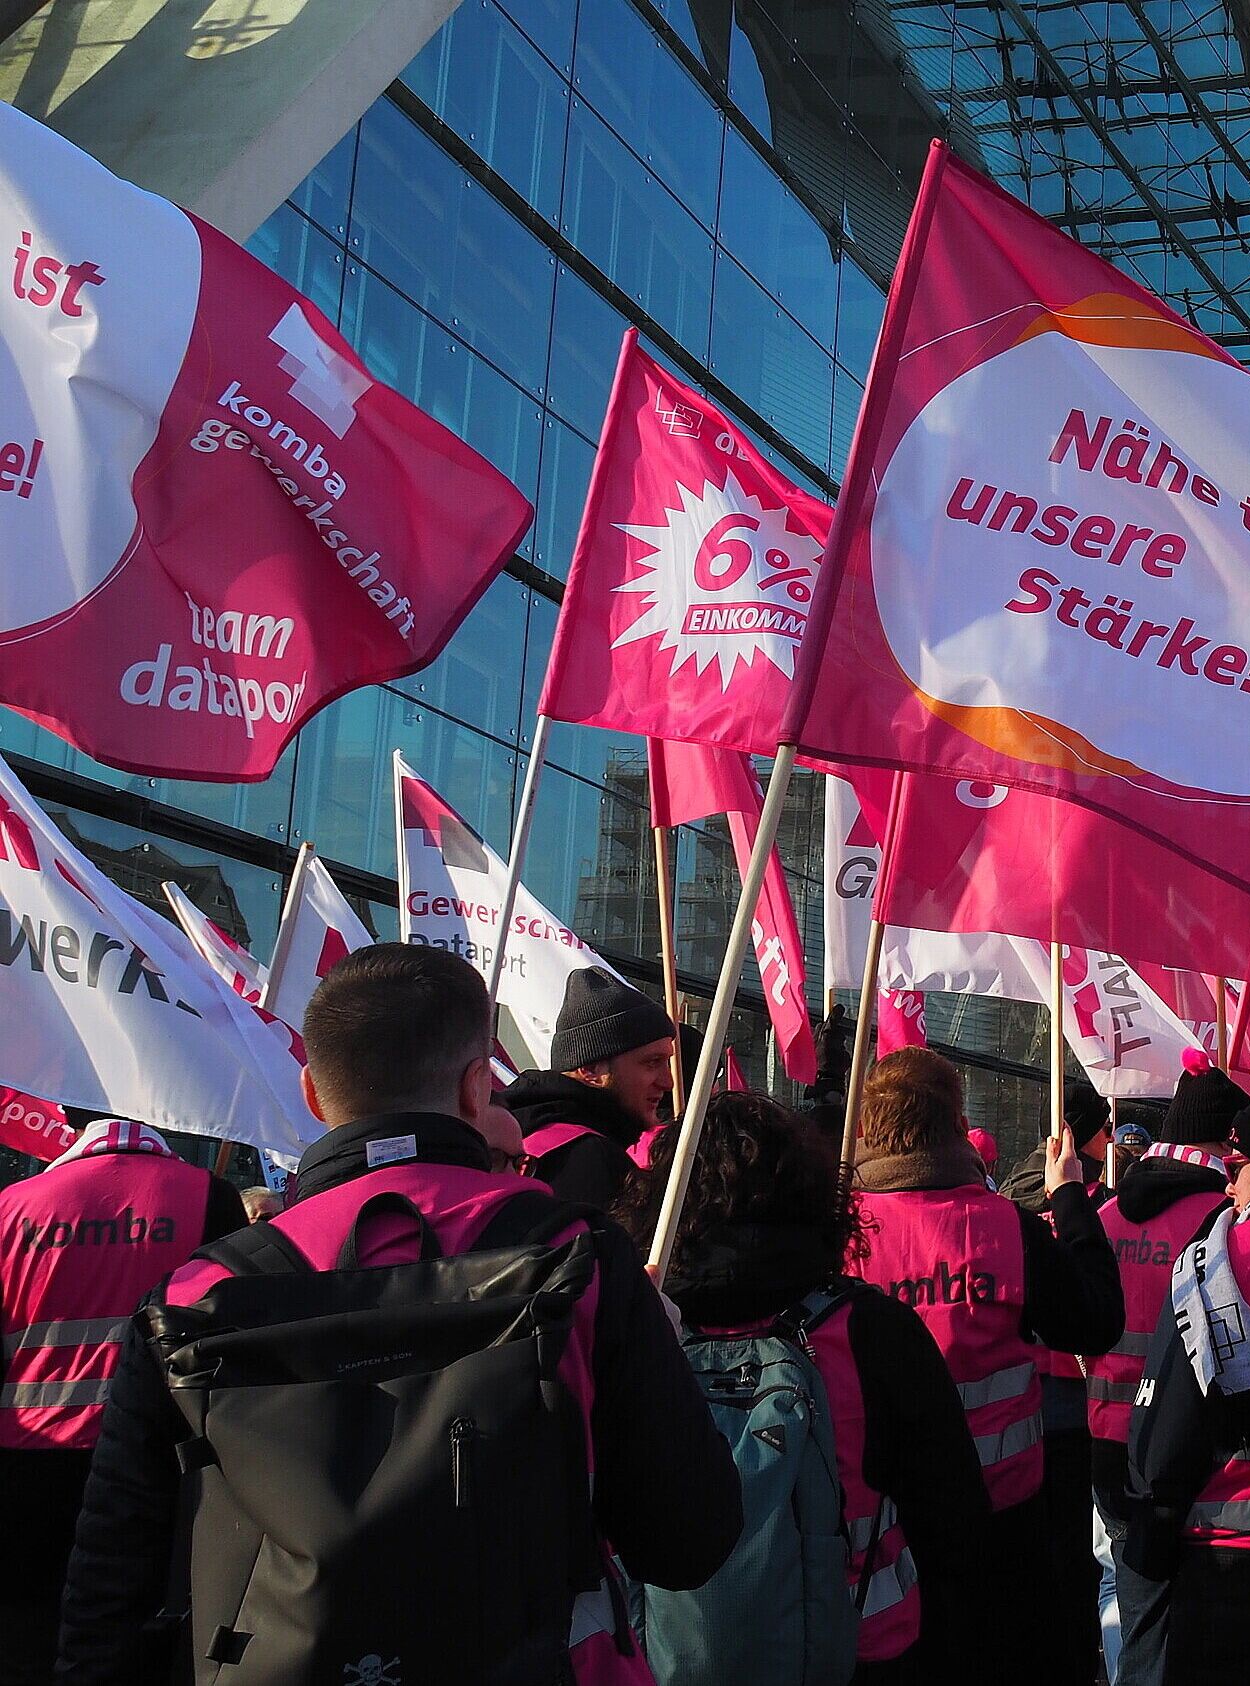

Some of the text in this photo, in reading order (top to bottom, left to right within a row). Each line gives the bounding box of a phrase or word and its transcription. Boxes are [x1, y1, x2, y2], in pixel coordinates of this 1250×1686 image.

[11, 231, 106, 317] ist
[217, 381, 347, 500] komba
[1048, 408, 1221, 507] Nähe
[190, 419, 416, 639] gewerkschaft
[946, 477, 1187, 578] unsere
[185, 591, 294, 659] team
[689, 607, 806, 635] EINKOMM
[121, 643, 306, 738] datapor
[407, 891, 598, 954] Gewerscha
[888, 1261, 996, 1305] mba
[1114, 1230, 1171, 1265] mba
